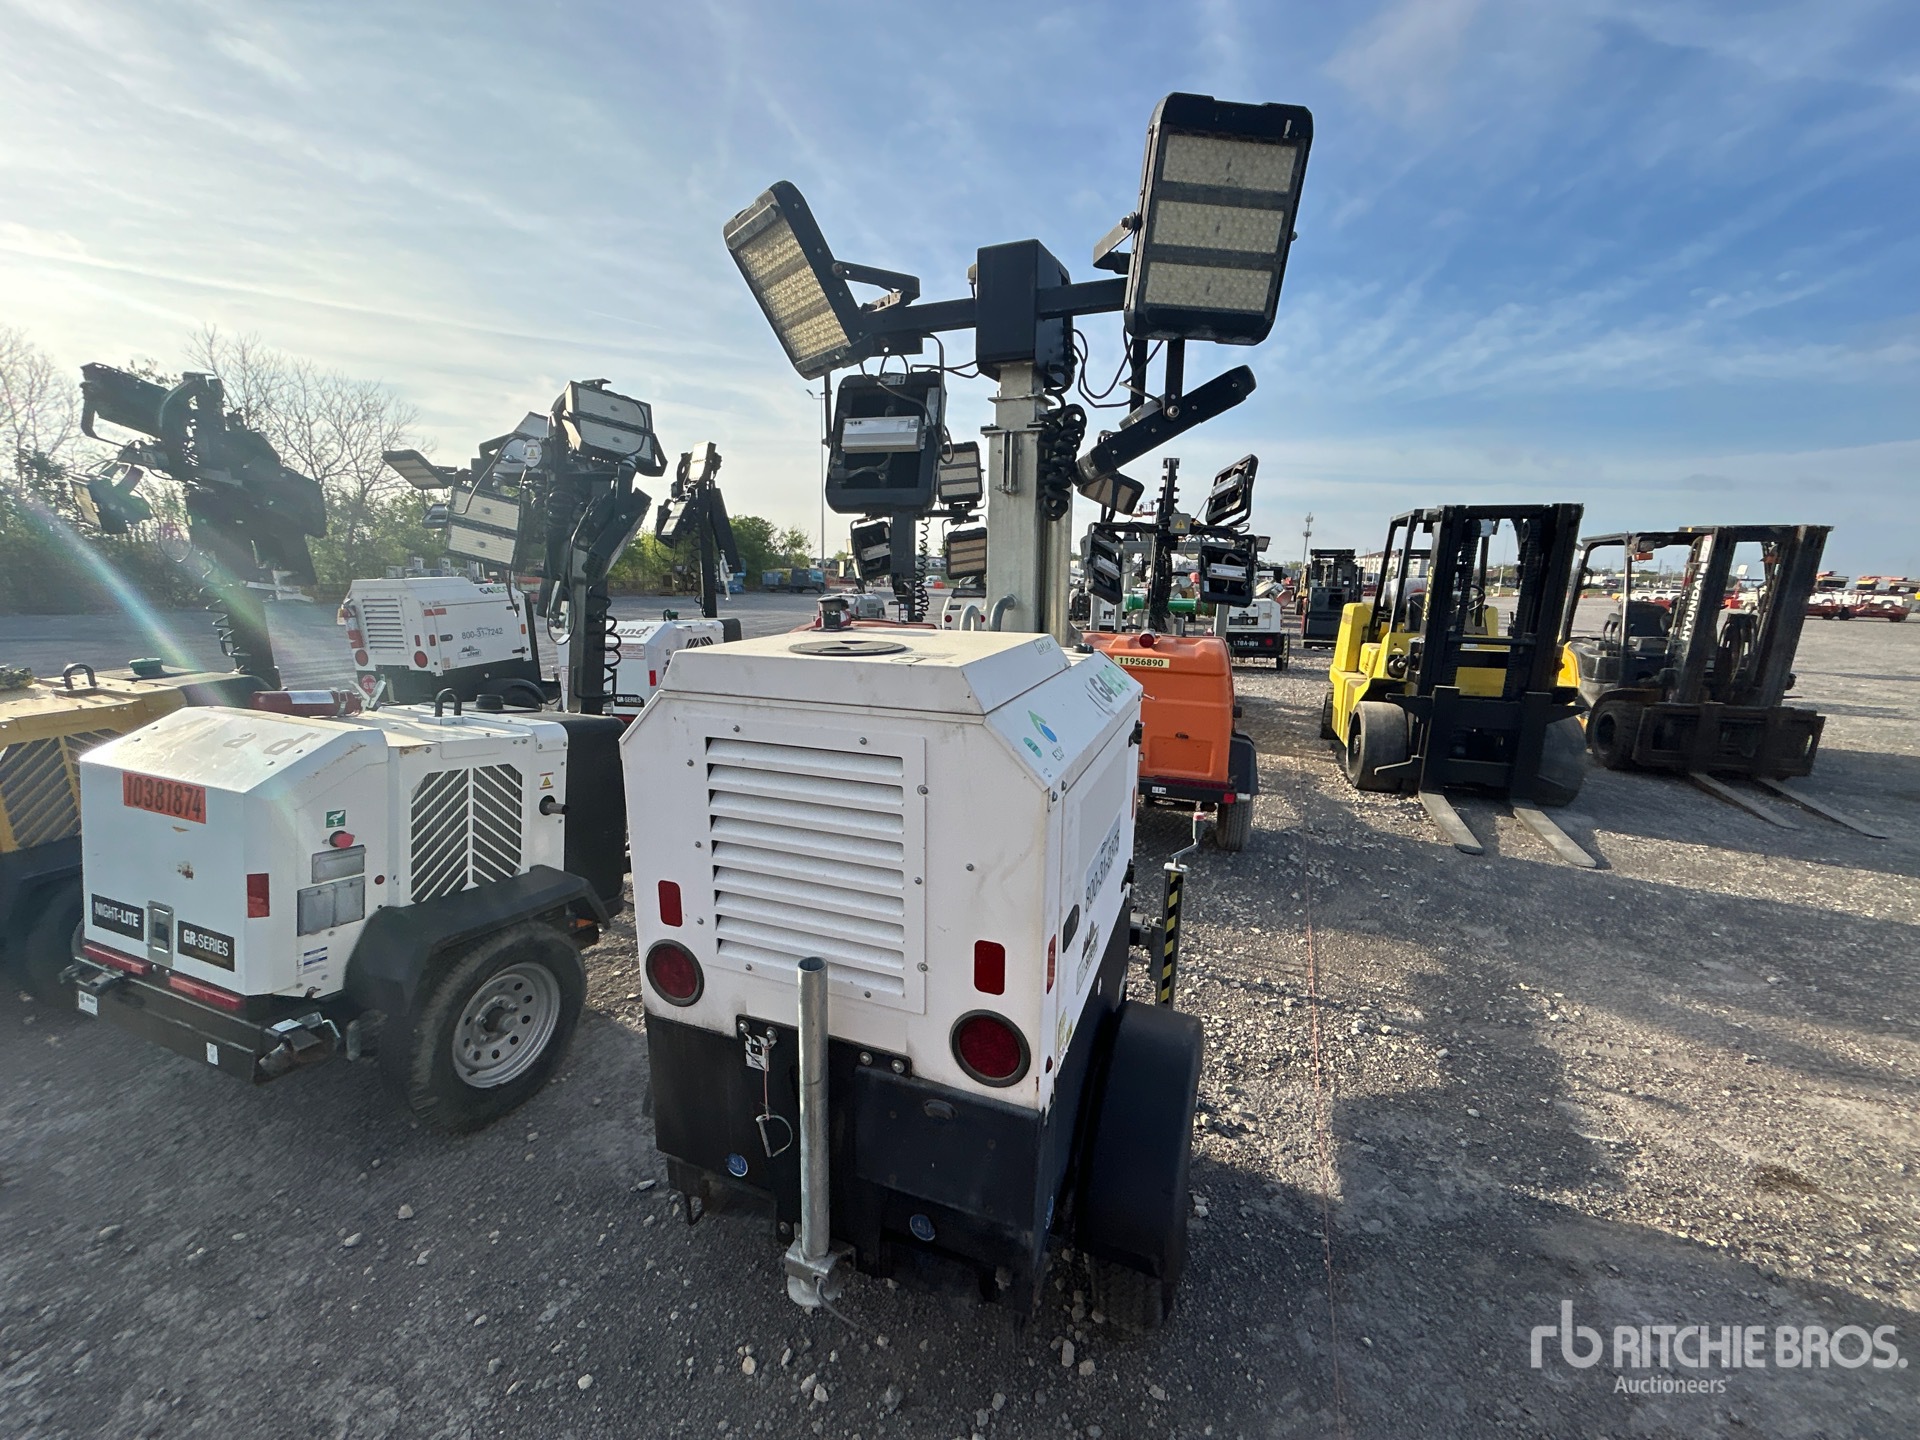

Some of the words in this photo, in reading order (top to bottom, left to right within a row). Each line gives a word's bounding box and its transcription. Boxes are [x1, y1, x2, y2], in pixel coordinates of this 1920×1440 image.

[1681, 574, 1704, 641] HYUNDAI
[461, 627, 503, 640] 800-31-7242
[1119, 657, 1164, 667] 11956890
[125, 775, 202, 820] 10381874
[94, 901, 140, 928] NIGHT-LITE
[183, 929, 229, 957] GR-SERIES
